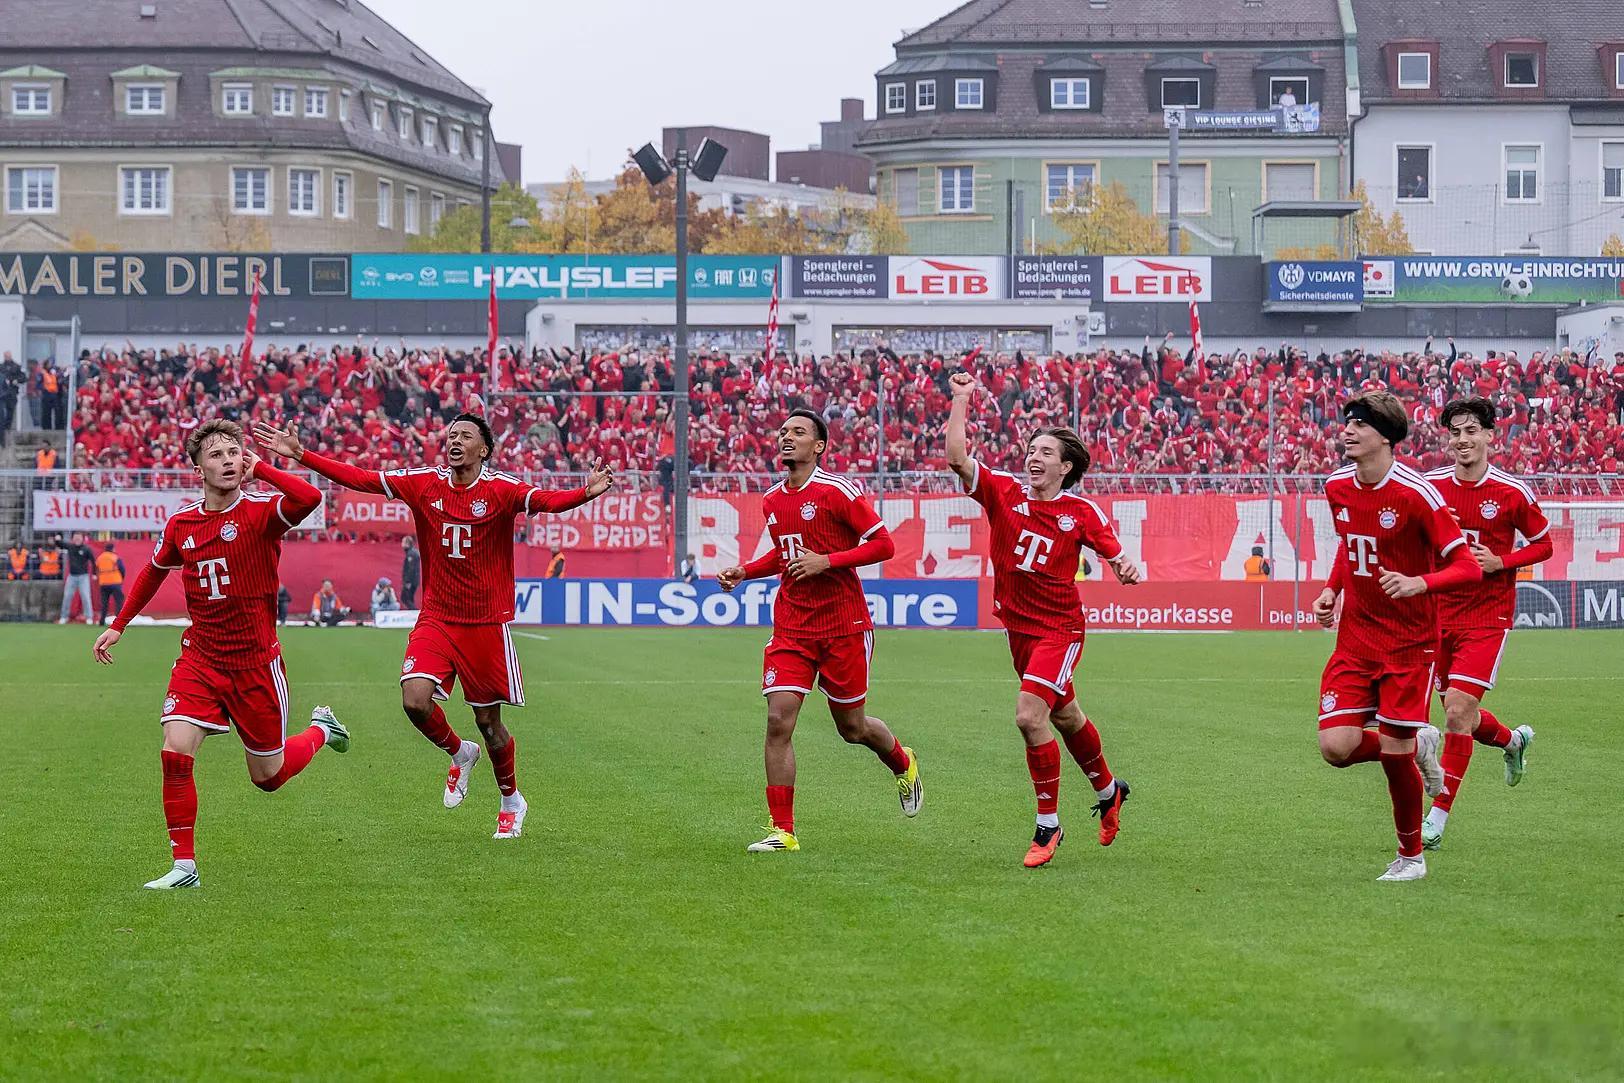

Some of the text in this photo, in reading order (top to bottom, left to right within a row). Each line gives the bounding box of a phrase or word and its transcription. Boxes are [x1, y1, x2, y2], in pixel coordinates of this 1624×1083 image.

[803, 260, 863, 272] Spenglerei
[1018, 260, 1078, 273] Spenglerei
[1404, 261, 1624, 278] WWW.GRW-EINRICHTU
[0, 255, 291, 295] MALER DIERL
[803, 271, 876, 284] Bedachungen
[1018, 271, 1091, 284] Bedachungen
[1308, 270, 1356, 283] VDMAYR
[896, 275, 989, 295] LEIB
[1110, 275, 1203, 295] LEIB
[1279, 291, 1354, 301] Sicherheitsdienste
[45, 495, 168, 525] Altenburg
[341, 502, 410, 522] ADLER
[533, 523, 580, 547] RED
[1269, 610, 1292, 624] Die
[1514, 612, 1556, 627] AN
